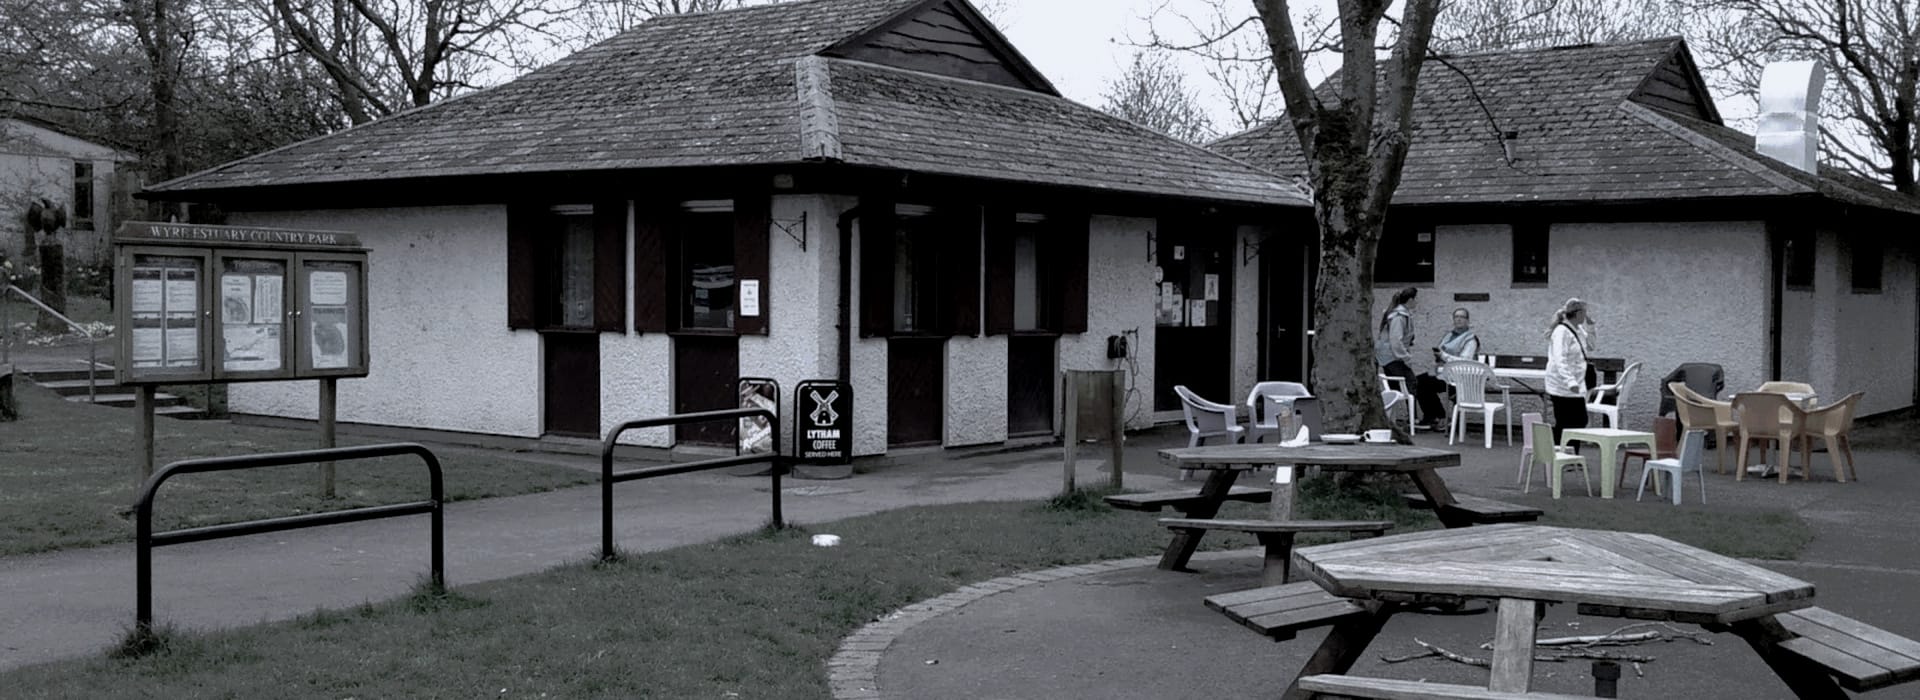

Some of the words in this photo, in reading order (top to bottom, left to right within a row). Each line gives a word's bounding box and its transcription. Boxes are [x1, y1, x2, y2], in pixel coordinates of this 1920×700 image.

[193, 226, 248, 241] ESTUARY
[250, 229, 305, 243] COUNTRY
[308, 232, 337, 245] PARK
[807, 429, 840, 439] LYTHAM
[812, 440, 836, 450] COFFEE
[804, 451, 826, 459] SERVED
